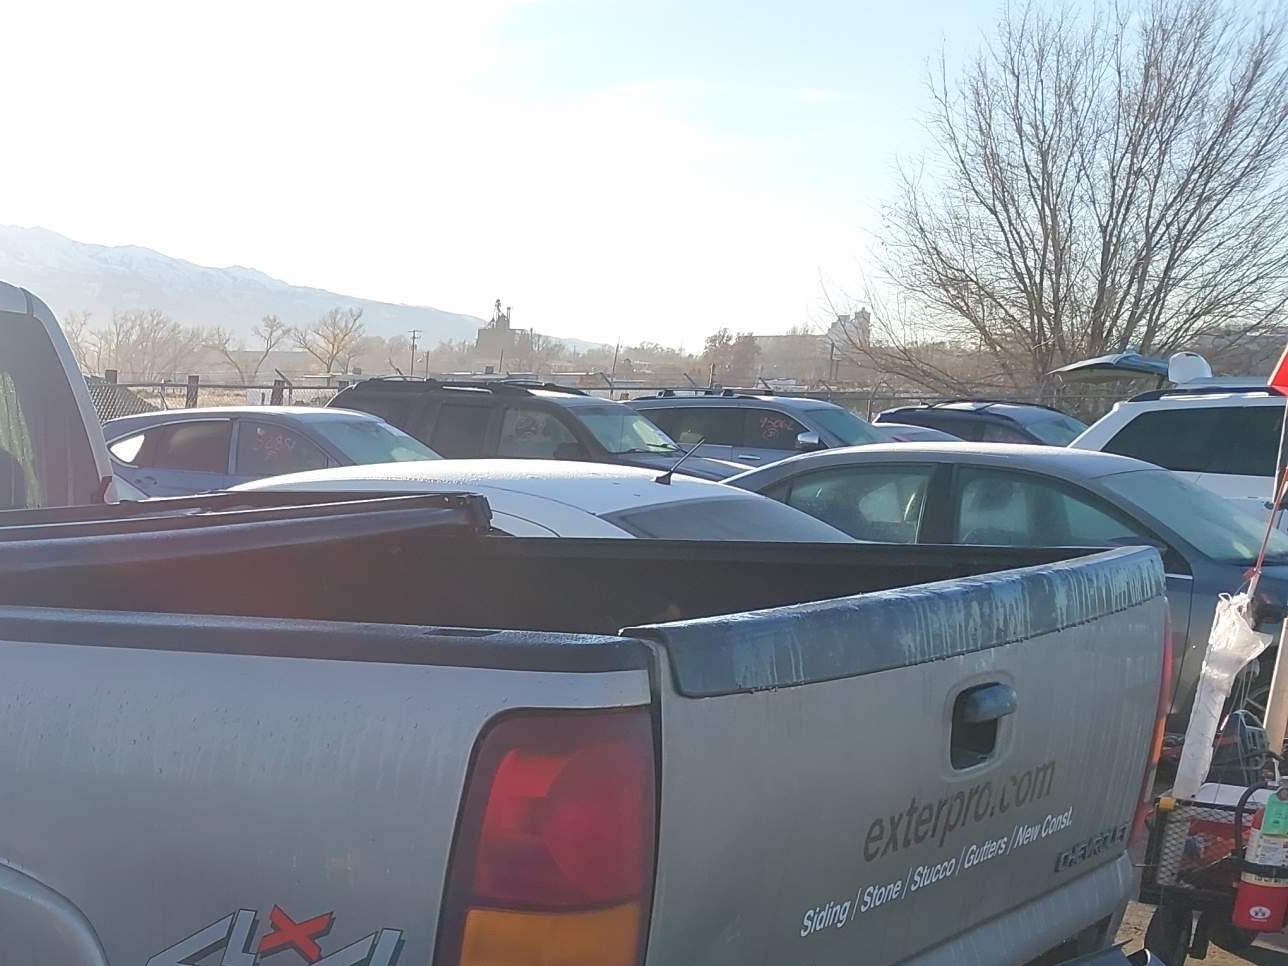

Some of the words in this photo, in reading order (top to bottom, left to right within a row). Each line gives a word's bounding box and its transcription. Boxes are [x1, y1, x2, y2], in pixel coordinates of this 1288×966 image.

[863, 760, 1056, 863] exterpro.com
[800, 901, 853, 938] Siding
[860, 880, 903, 913] Stone
[911, 857, 957, 892] Stucco
[964, 836, 1008, 869] Gutters
[1014, 824, 1040, 849] New
[1041, 806, 1073, 839] Const.
